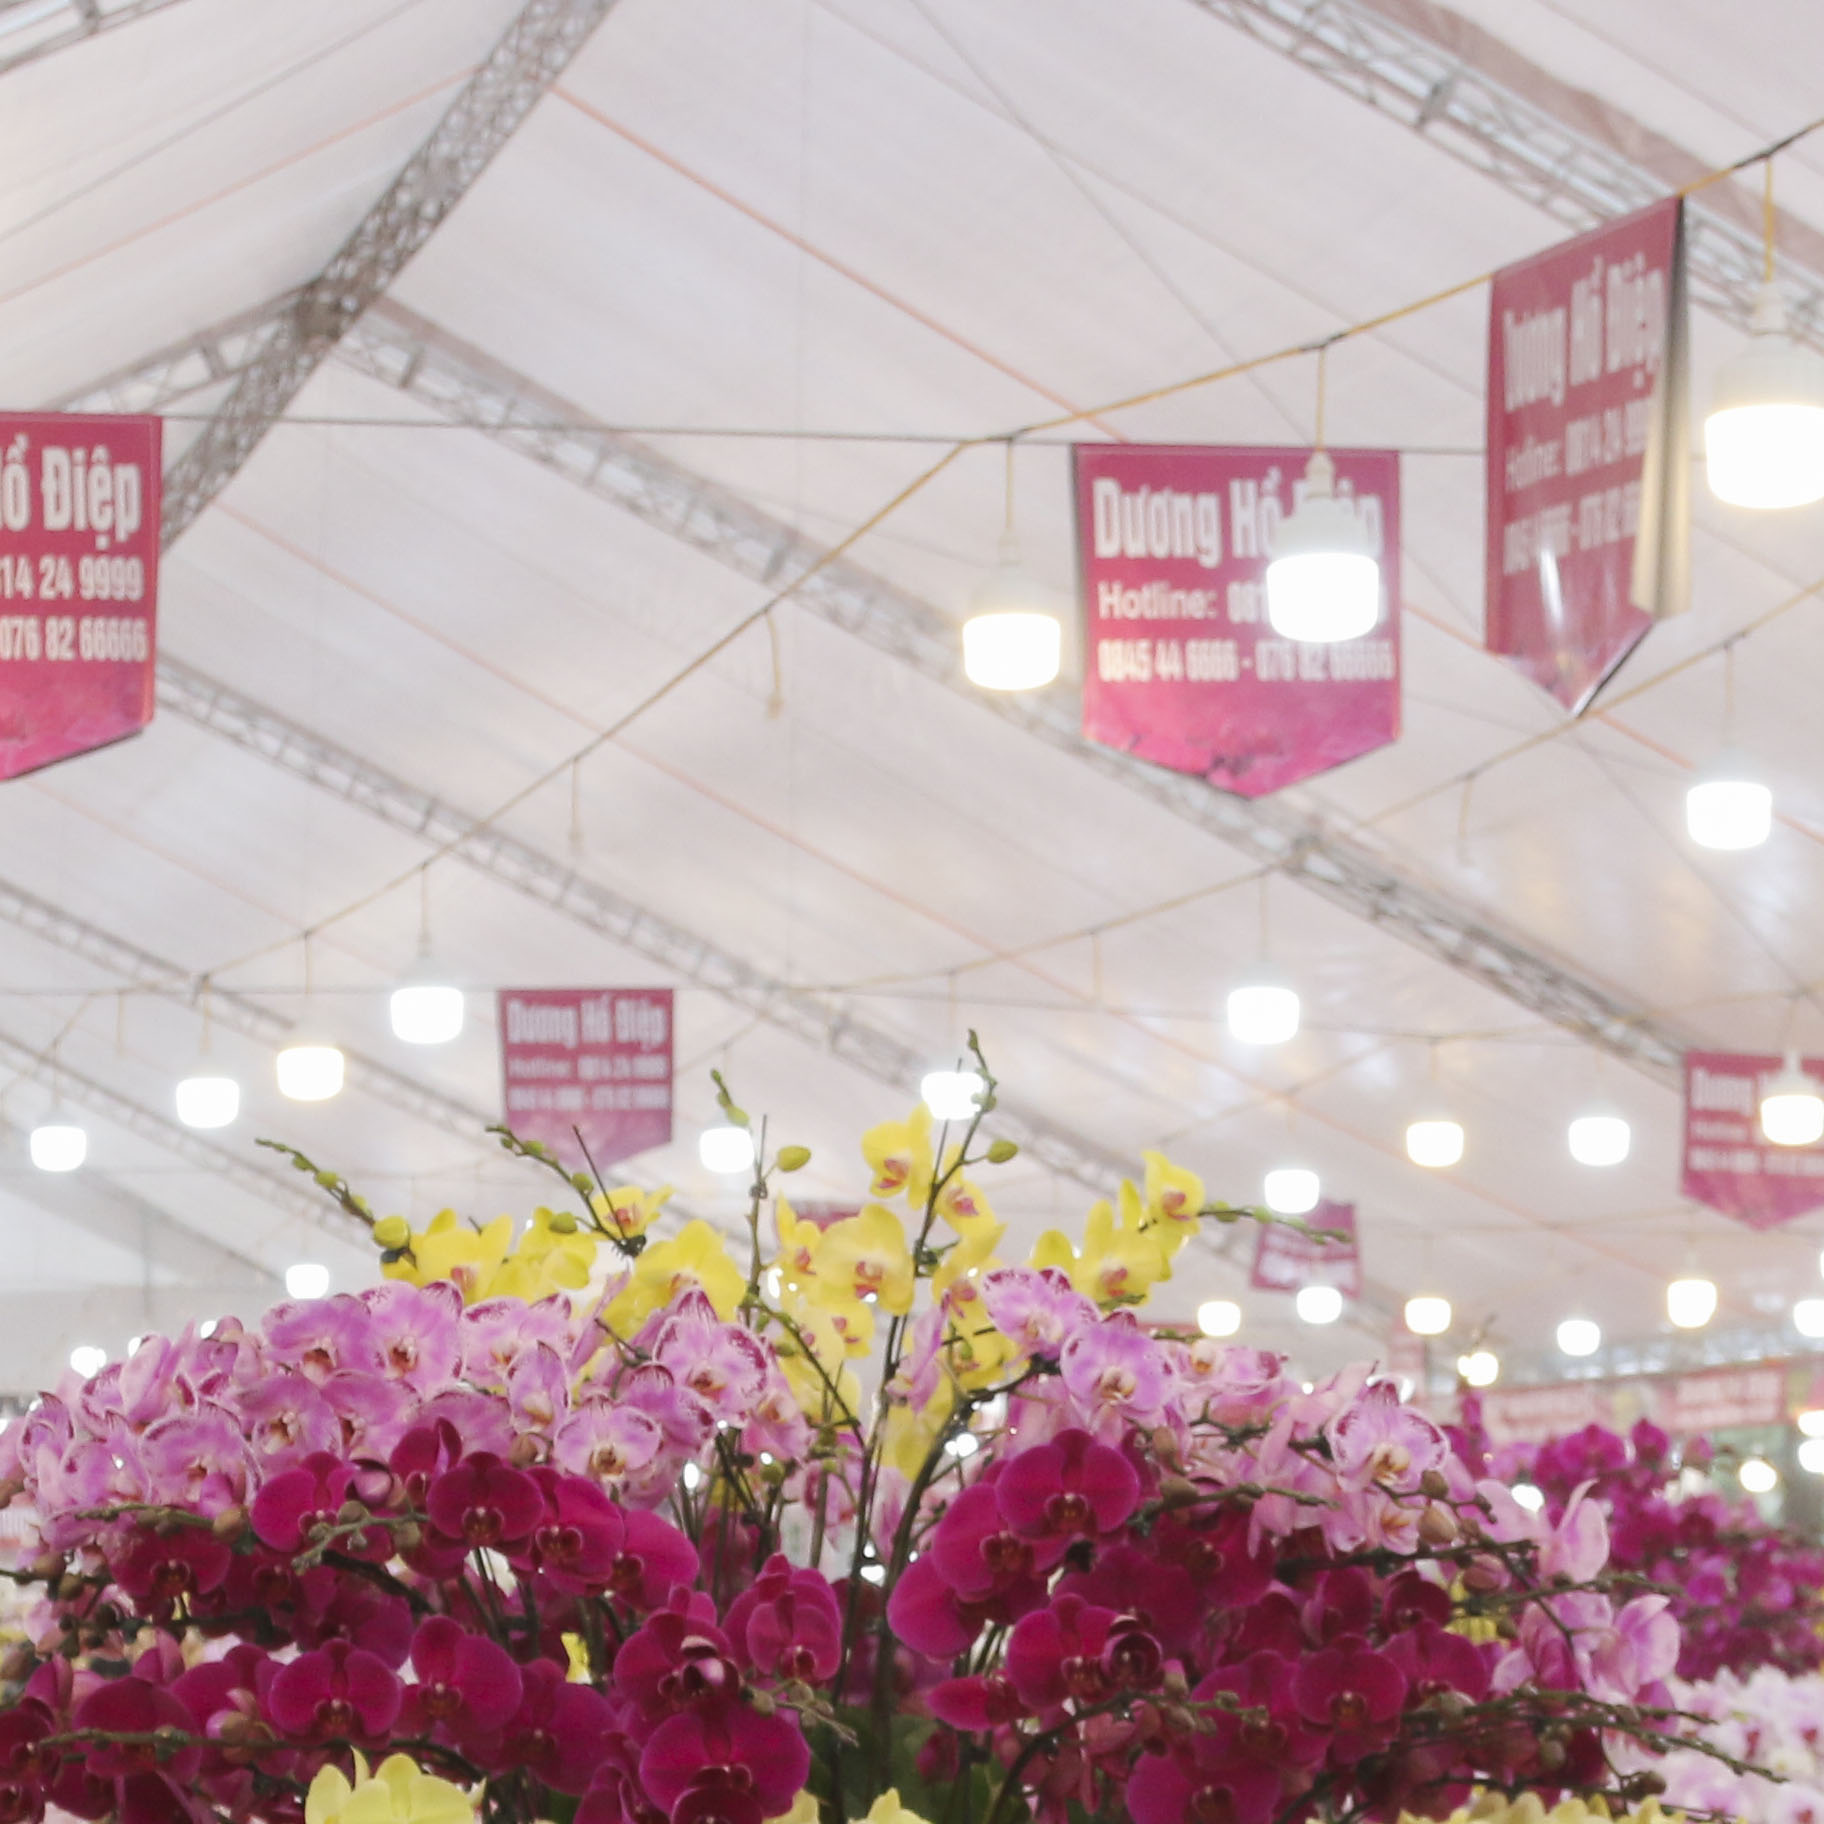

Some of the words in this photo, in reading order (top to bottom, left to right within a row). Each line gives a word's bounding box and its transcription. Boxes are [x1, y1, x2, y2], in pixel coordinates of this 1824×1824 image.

[41, 446, 142, 549] Điệp
[1092, 477, 1222, 569] Dương
[40, 556, 74, 600] 24
[79, 556, 144, 601] 9999
[45, 616, 74, 661] 82
